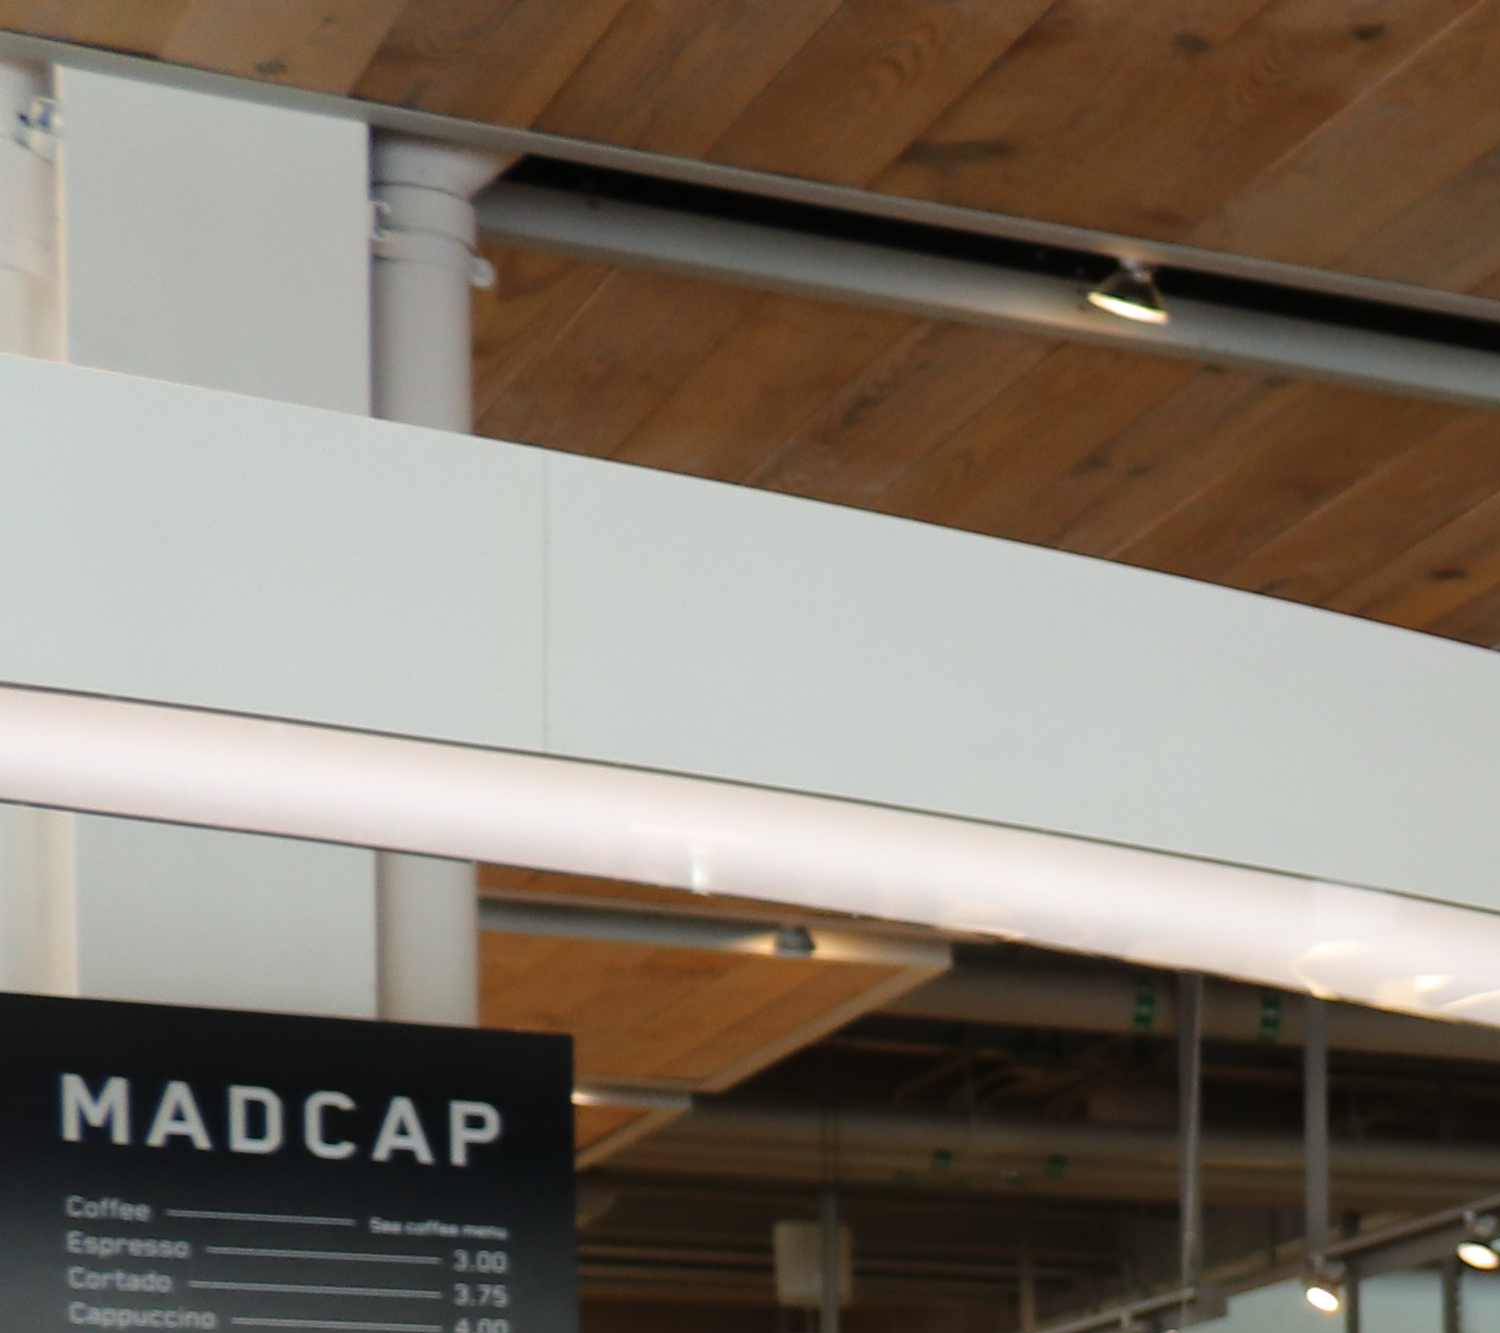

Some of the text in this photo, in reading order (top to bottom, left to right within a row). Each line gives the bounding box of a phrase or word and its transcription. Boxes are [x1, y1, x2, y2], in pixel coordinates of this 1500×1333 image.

[60, 1072, 502, 1167] MADCAP
[66, 1195, 152, 1222] Coffee
[66, 1230, 509, 1274] Espresso 3.00
[67, 1265, 509, 1308] Cortado 3.75
[68, 1301, 219, 1330] Cappuccino
